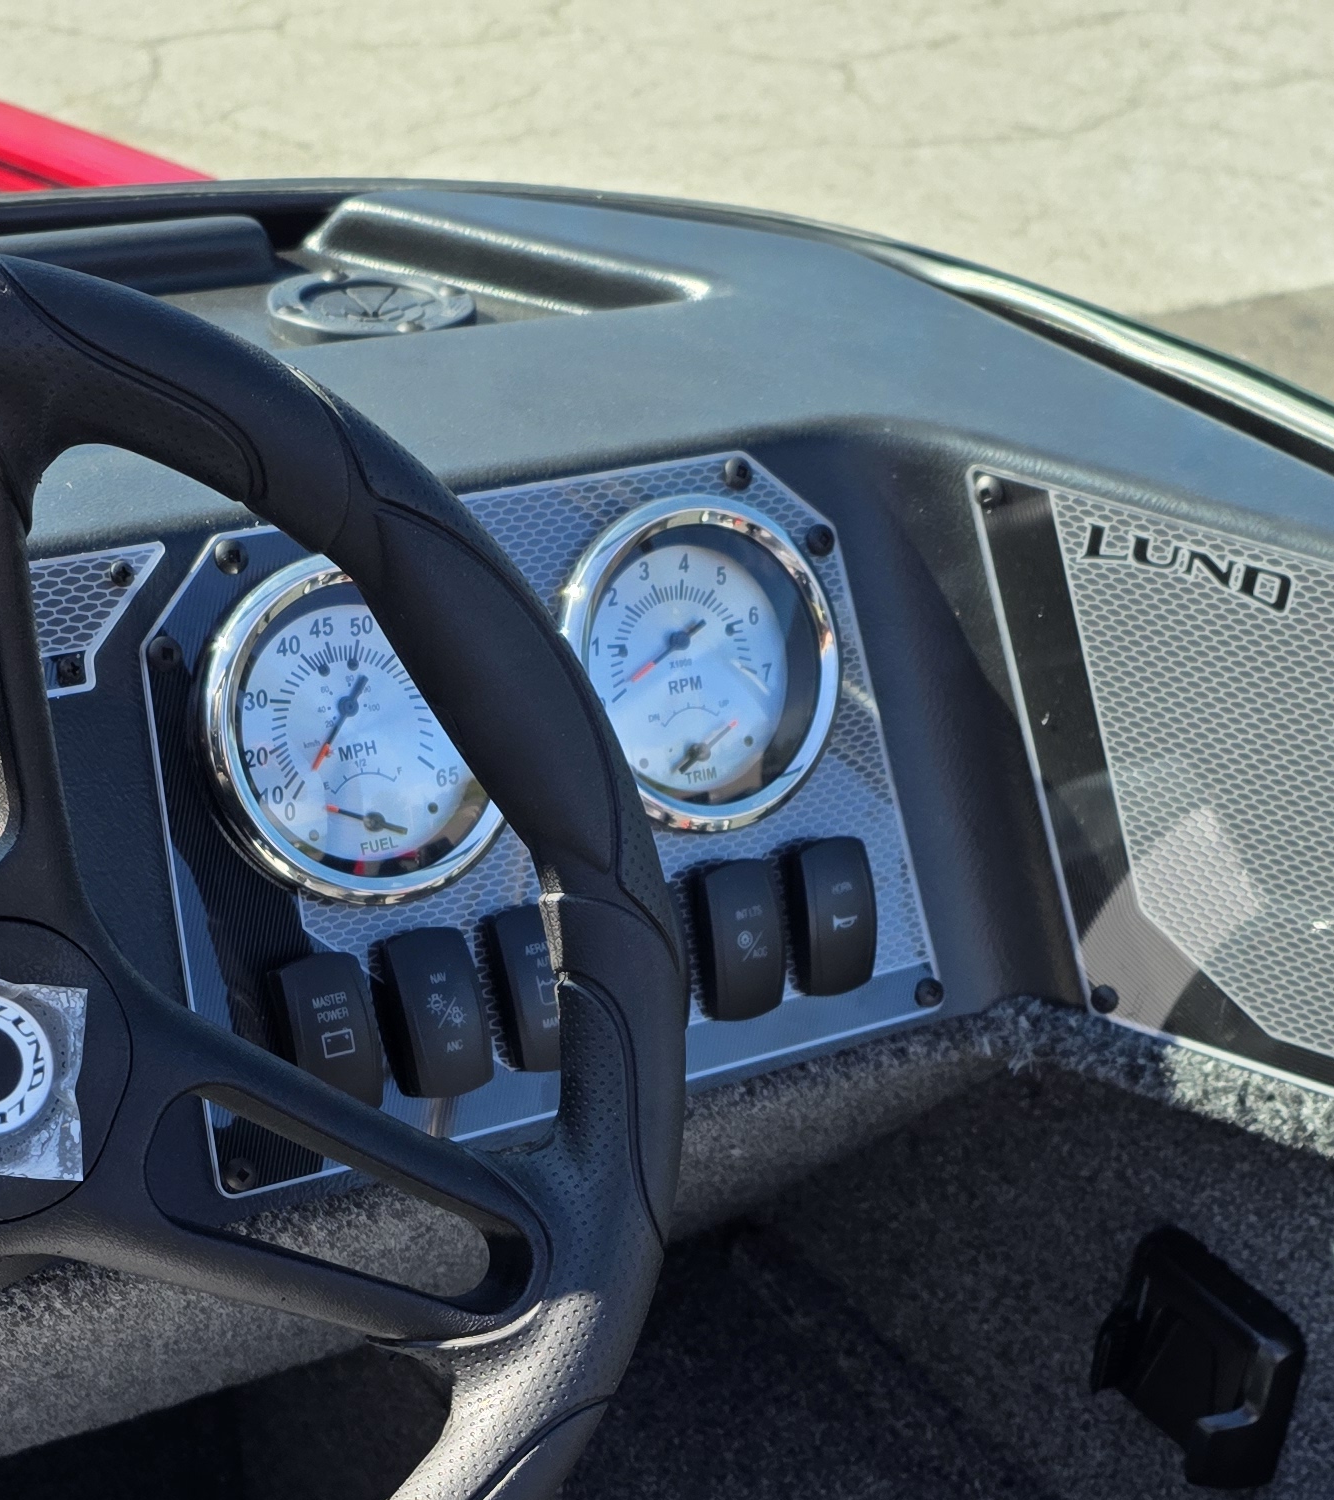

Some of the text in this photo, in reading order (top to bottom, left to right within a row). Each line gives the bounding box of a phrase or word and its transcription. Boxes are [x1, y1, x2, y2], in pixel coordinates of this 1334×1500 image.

[638, 562, 650, 582] 3
[679, 553, 689, 573] 4
[1079, 522, 1292, 614] LUND
[716, 565, 727, 586] 5
[607, 587, 618, 608] 2
[309, 616, 335, 638] 45
[349, 614, 374, 637] 50
[748, 606, 760, 627] 6
[276, 634, 301, 657] 40
[591, 637, 600, 656] 1
[761, 662, 773, 682] 7
[668, 675, 704, 696] RPM
[243, 689, 268, 712] 30
[244, 746, 269, 768] 20
[337, 739, 378, 762] MPH
[436, 765, 460, 788] 65
[684, 766, 718, 785] TRIM
[258, 785, 284, 805] 10
[283, 802, 297, 822] 0
[359, 835, 399, 856] FUEL
[429, 972, 447, 985] NAV
[311, 991, 348, 1009] MASTER
[316, 1006, 349, 1024] POWER
[446, 1039, 464, 1053] ANC
